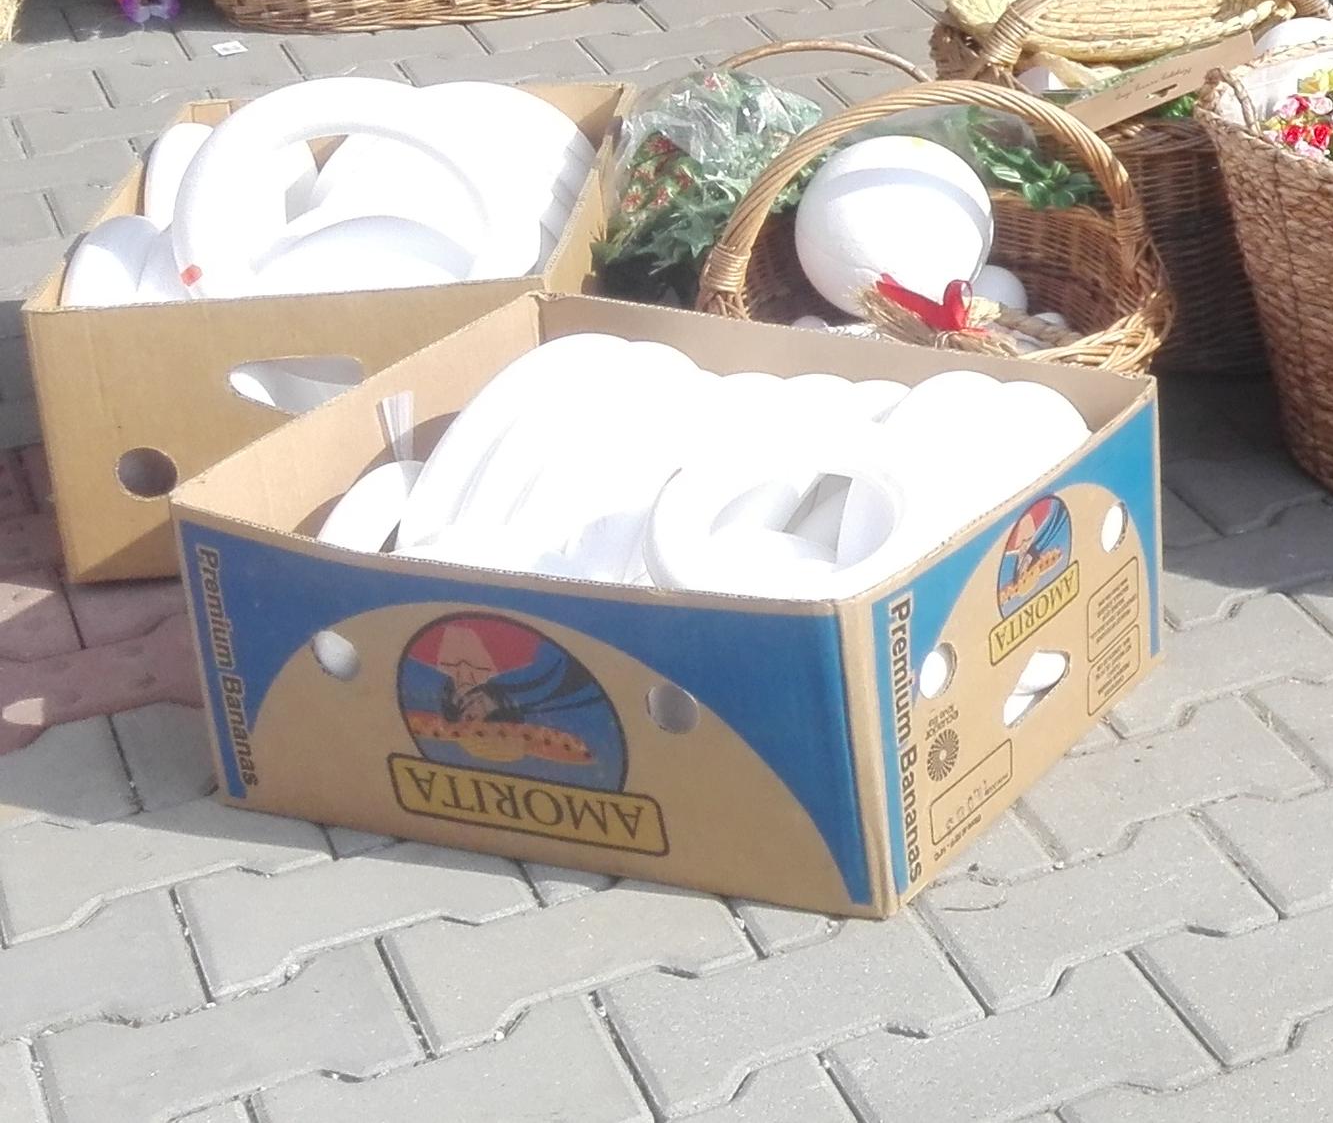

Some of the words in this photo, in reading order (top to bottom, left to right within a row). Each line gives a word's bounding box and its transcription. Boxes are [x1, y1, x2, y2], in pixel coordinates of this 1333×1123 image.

[199, 548, 233, 668] Premium
[222, 675, 260, 787] Bananas
[891, 598, 915, 741] Premium
[993, 571, 1074, 653] AMORITA
[403, 765, 646, 841] AMORITA
[899, 744, 923, 885] Bananas
